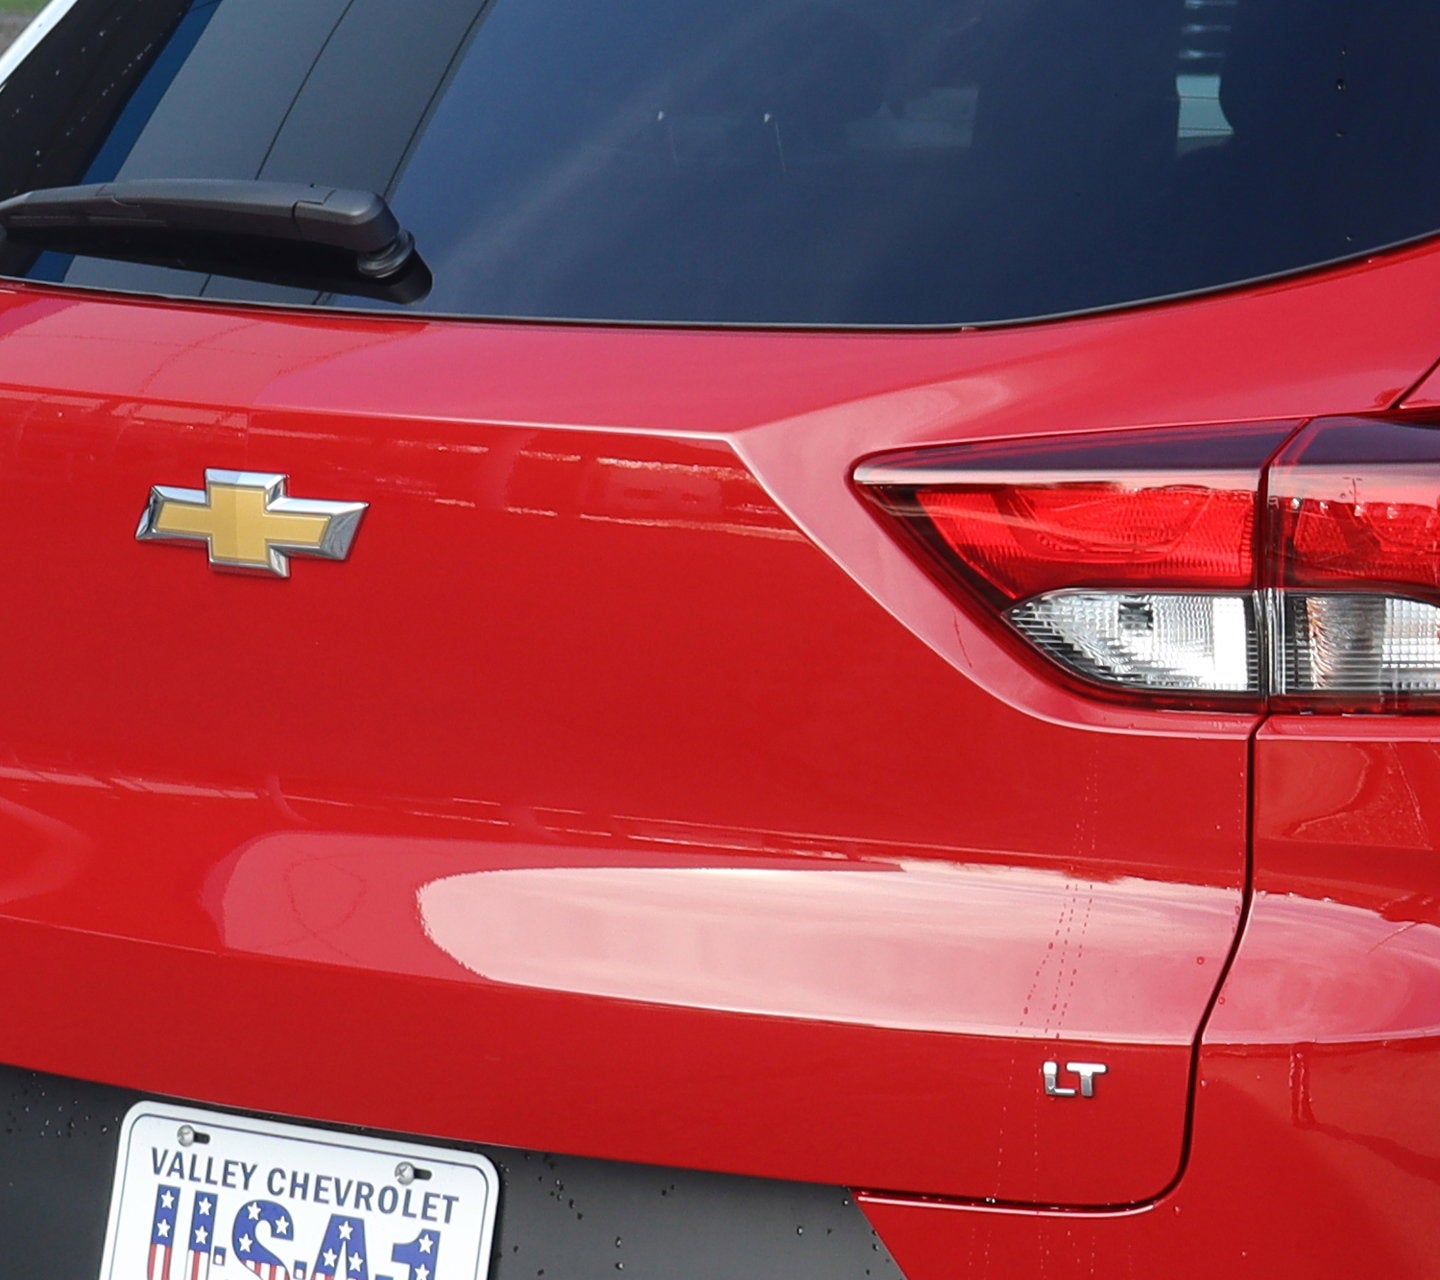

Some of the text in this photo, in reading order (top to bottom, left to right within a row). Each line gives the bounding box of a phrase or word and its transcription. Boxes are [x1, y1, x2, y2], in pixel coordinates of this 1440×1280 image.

[1042, 1061, 1108, 1097] LT
[150, 1146, 459, 1225] VALLEY CHEVROLET
